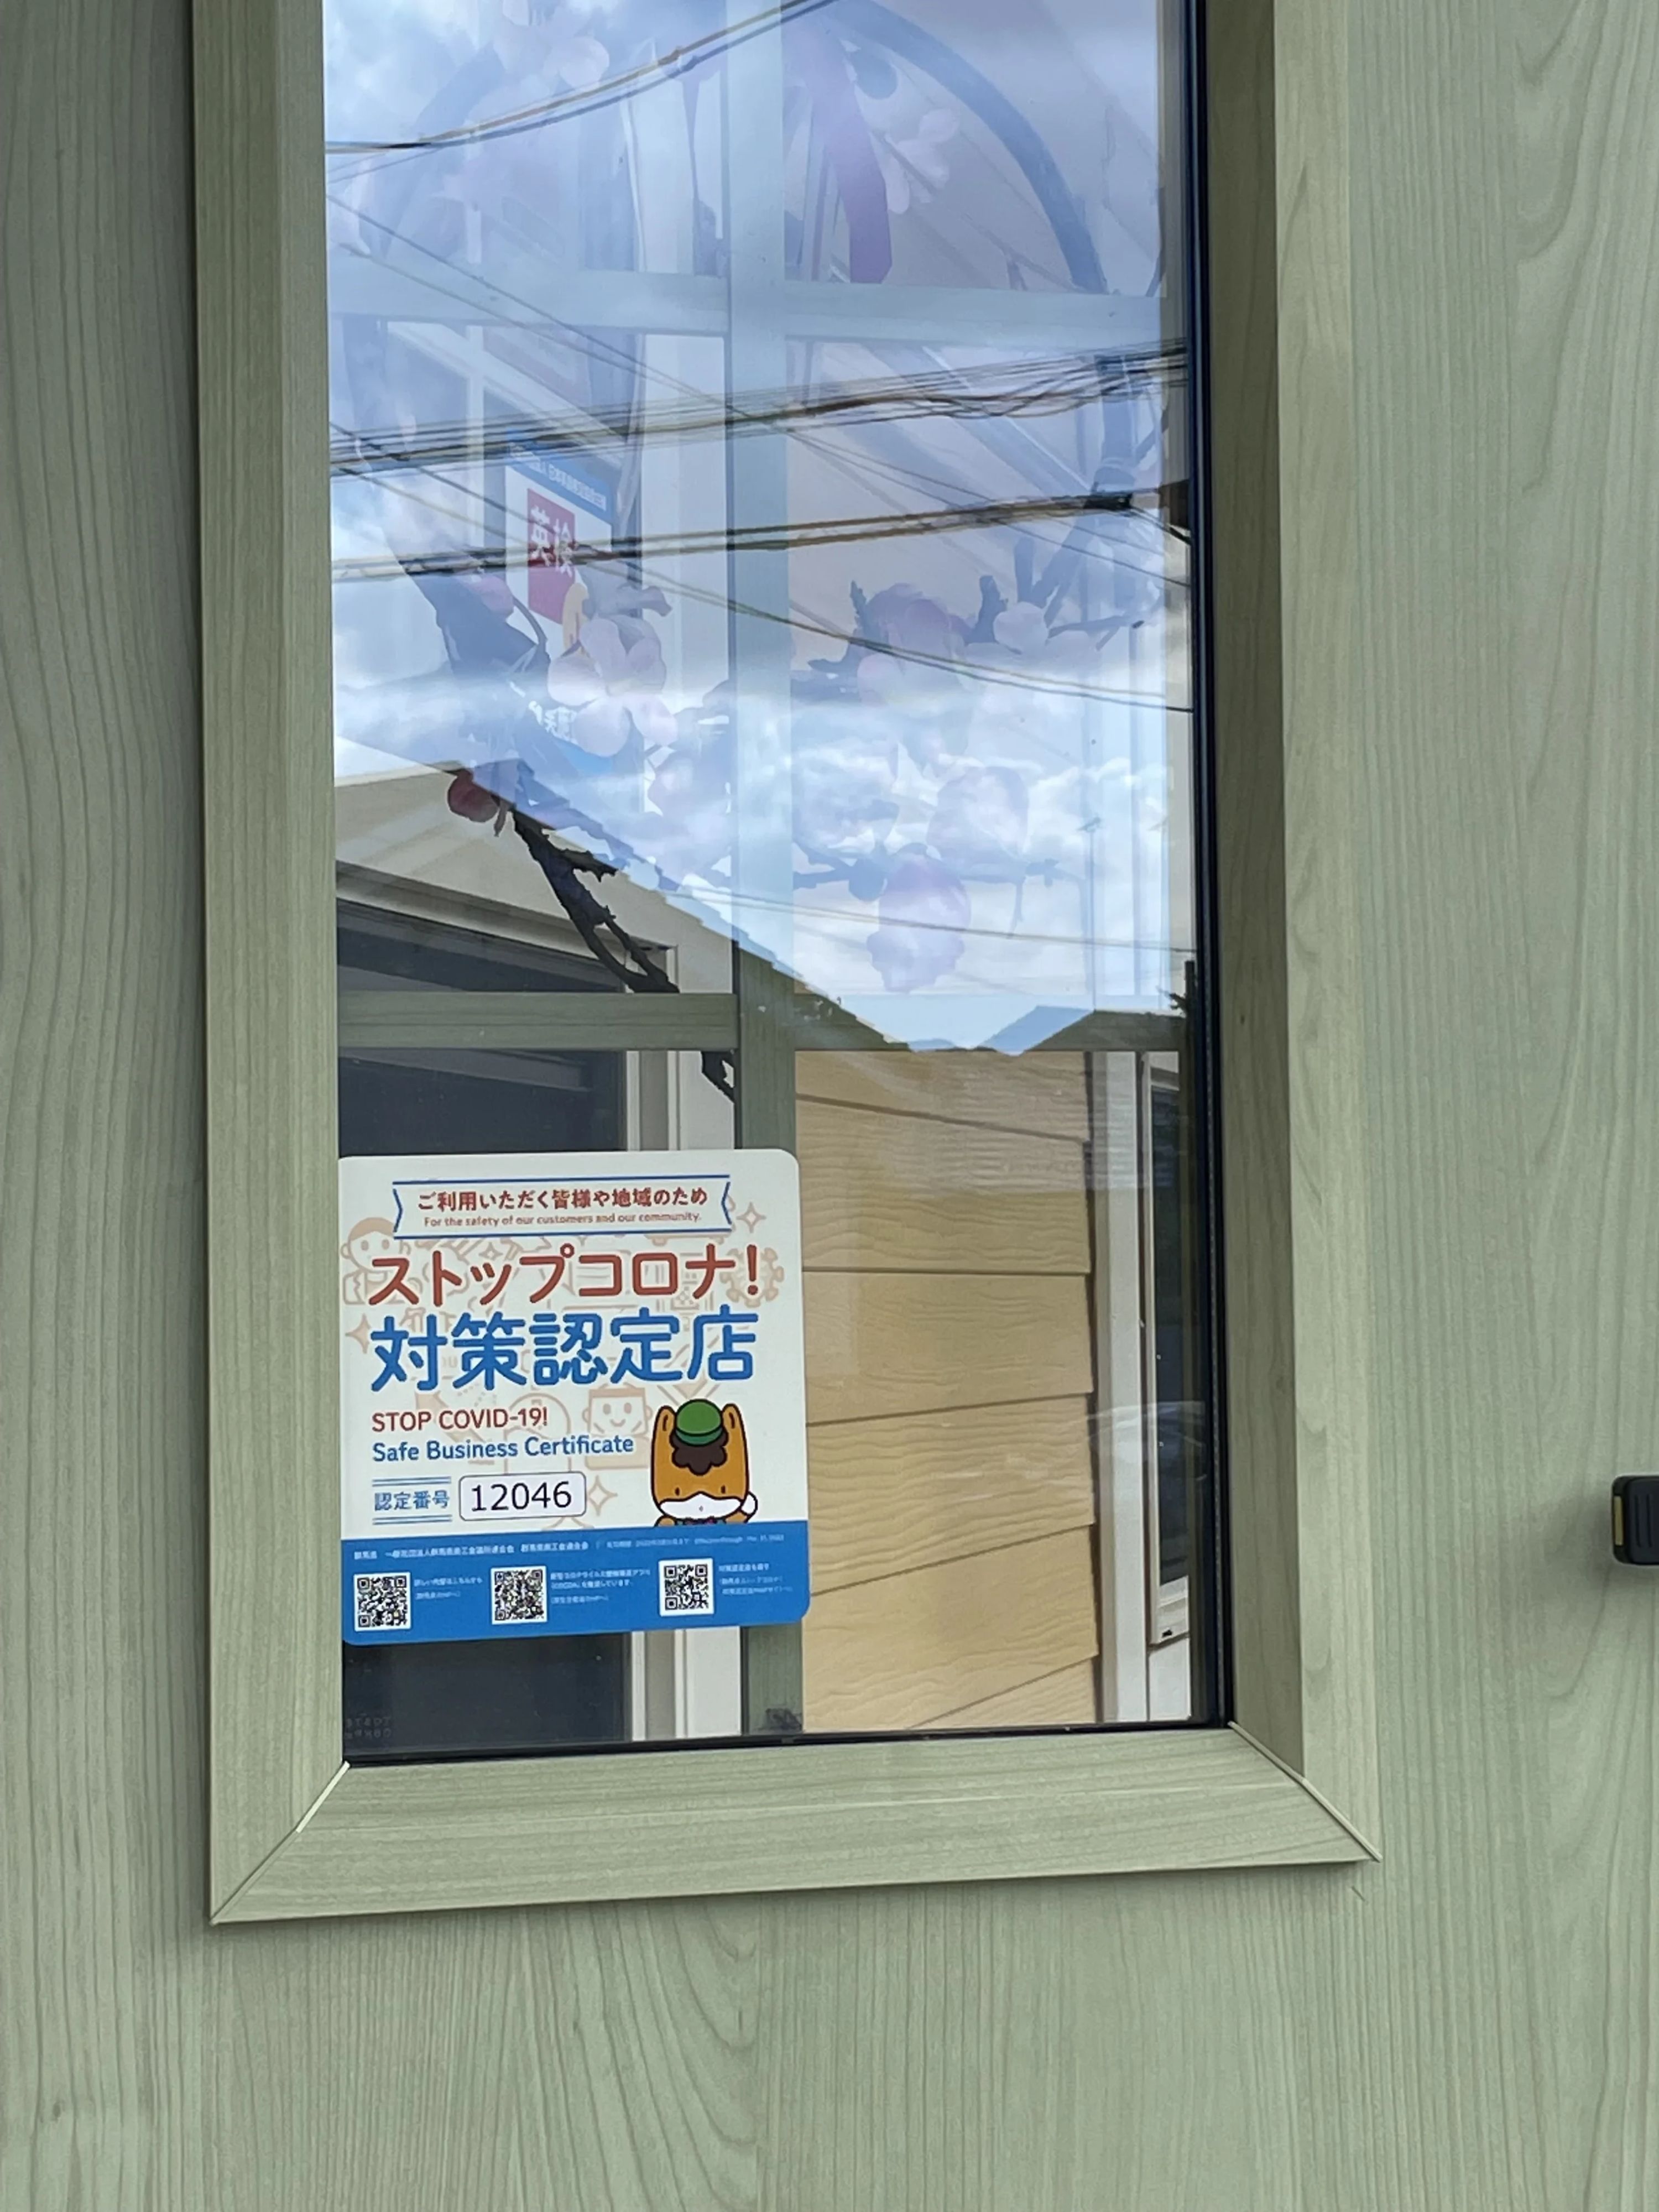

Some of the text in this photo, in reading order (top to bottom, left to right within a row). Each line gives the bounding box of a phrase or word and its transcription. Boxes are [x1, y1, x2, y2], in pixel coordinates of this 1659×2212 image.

[418, 1187, 708, 1212] ご利用いただく皆様や地域のため
[424, 1217, 441, 1227] For
[444, 1217, 463, 1226] the
[465, 1216, 499, 1227] safety
[501, 1215, 514, 1224] of
[515, 1216, 534, 1224] our
[536, 1214, 593, 1224] customers
[596, 1213, 615, 1223] and
[617, 1213, 637, 1222] our
[370, 1303, 759, 1393] 対策認定店
[372, 1406, 548, 1432] STOP COVID-19!
[372, 1435, 634, 1462] Safe Business Certificate
[373, 1480, 572, 1513] 認定番号 12046
